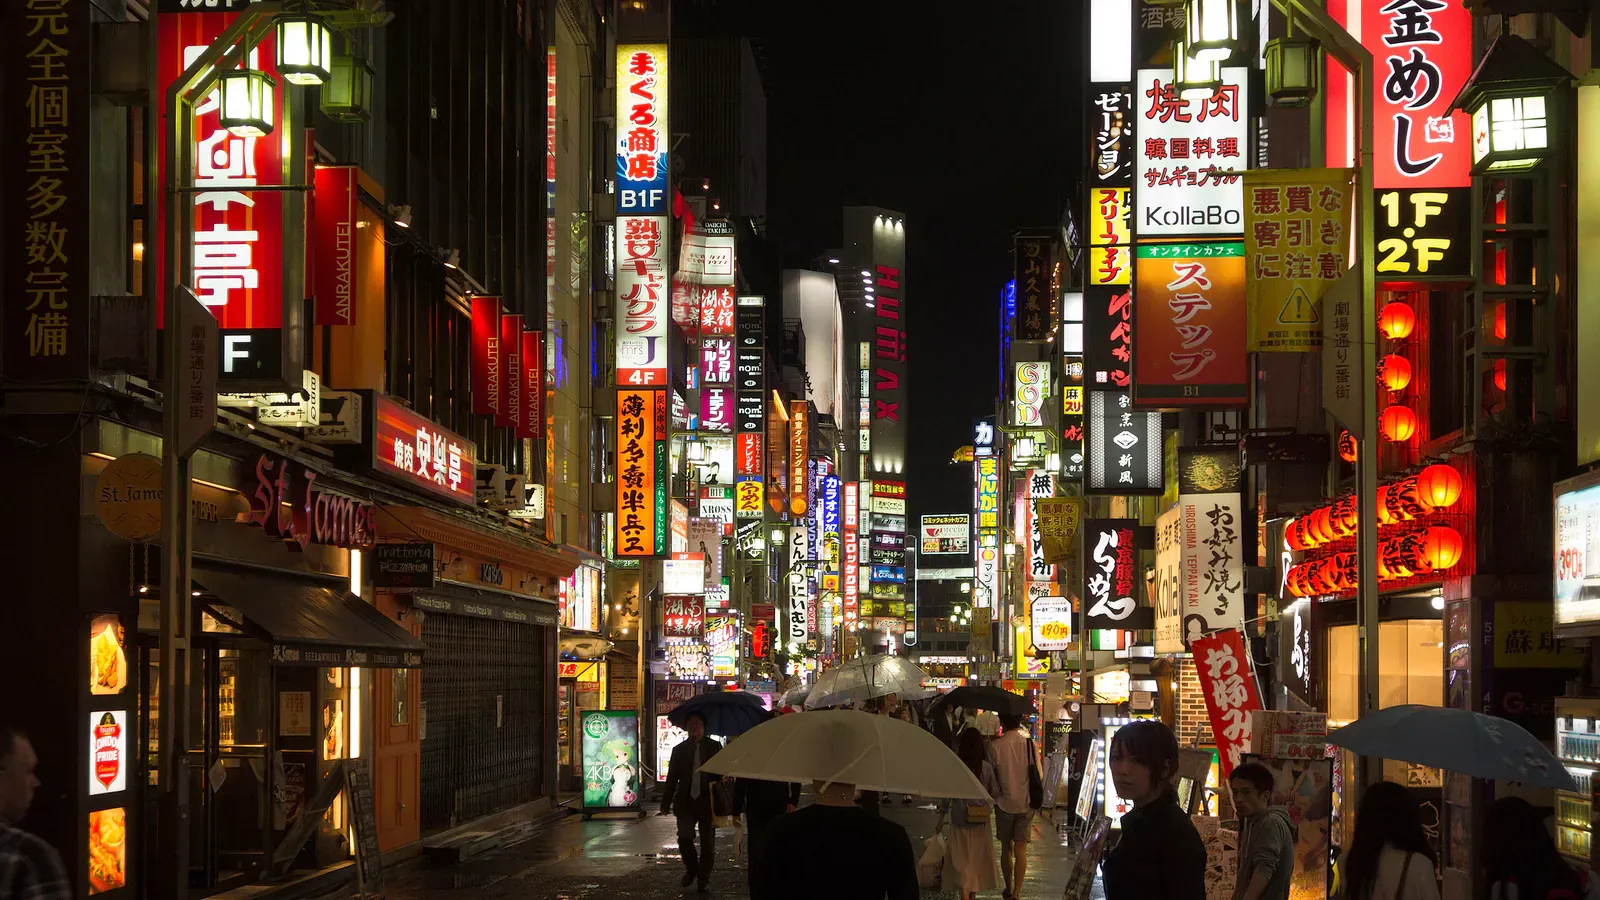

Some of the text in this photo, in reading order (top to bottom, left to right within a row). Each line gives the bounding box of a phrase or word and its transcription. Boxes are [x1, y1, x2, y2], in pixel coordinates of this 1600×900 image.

[1141, 6, 1187, 29] 酒場
[629, 52, 656, 179] まぐろ商店
[1145, 78, 1240, 123] 焼肉
[1144, 137, 1240, 160] 韓国料理
[1144, 164, 1239, 188] サムギョプサル
[621, 189, 663, 208] B1F
[1252, 185, 1344, 215] 悪質な
[1146, 205, 1240, 226] KollaBo
[1098, 189, 1121, 287] スリーファイブ
[1149, 245, 1235, 256] オンラインカフェ
[1253, 219, 1344, 249] 客引き
[336, 221, 351, 320] ANRAKUTEI
[1254, 250, 1344, 280] に注意
[1377, 238, 1451, 273] 2F
[1166, 261, 1216, 382] ステップ
[718, 339, 731, 382] レンタル
[1333, 301, 1350, 400] 劇場通り一番街
[488, 337, 499, 411] ANRAKUTEI
[508, 352, 519, 429] ANRAKUTEI
[628, 369, 655, 385] 4F
[528, 368, 539, 435] ANRAKUTEI
[709, 389, 725, 422] エデン
[1183, 386, 1200, 396] B1
[655, 394, 666, 434] 炭火串焼
[1117, 454, 1134, 484] 新風
[702, 505, 733, 515] XROSS
[740, 483, 759, 510] らーめん
[825, 477, 838, 522] カラオケ
[1185, 504, 1196, 549] HIROSHIMA
[1116, 527, 1135, 597] 東京豚骨
[1203, 503, 1242, 616] お好み焼き
[1155, 558, 1181, 620] Kolla
[704, 615, 730, 631] キラリ
[1041, 624, 1068, 636] 190円
[97, 751, 118, 762] PRIDE
